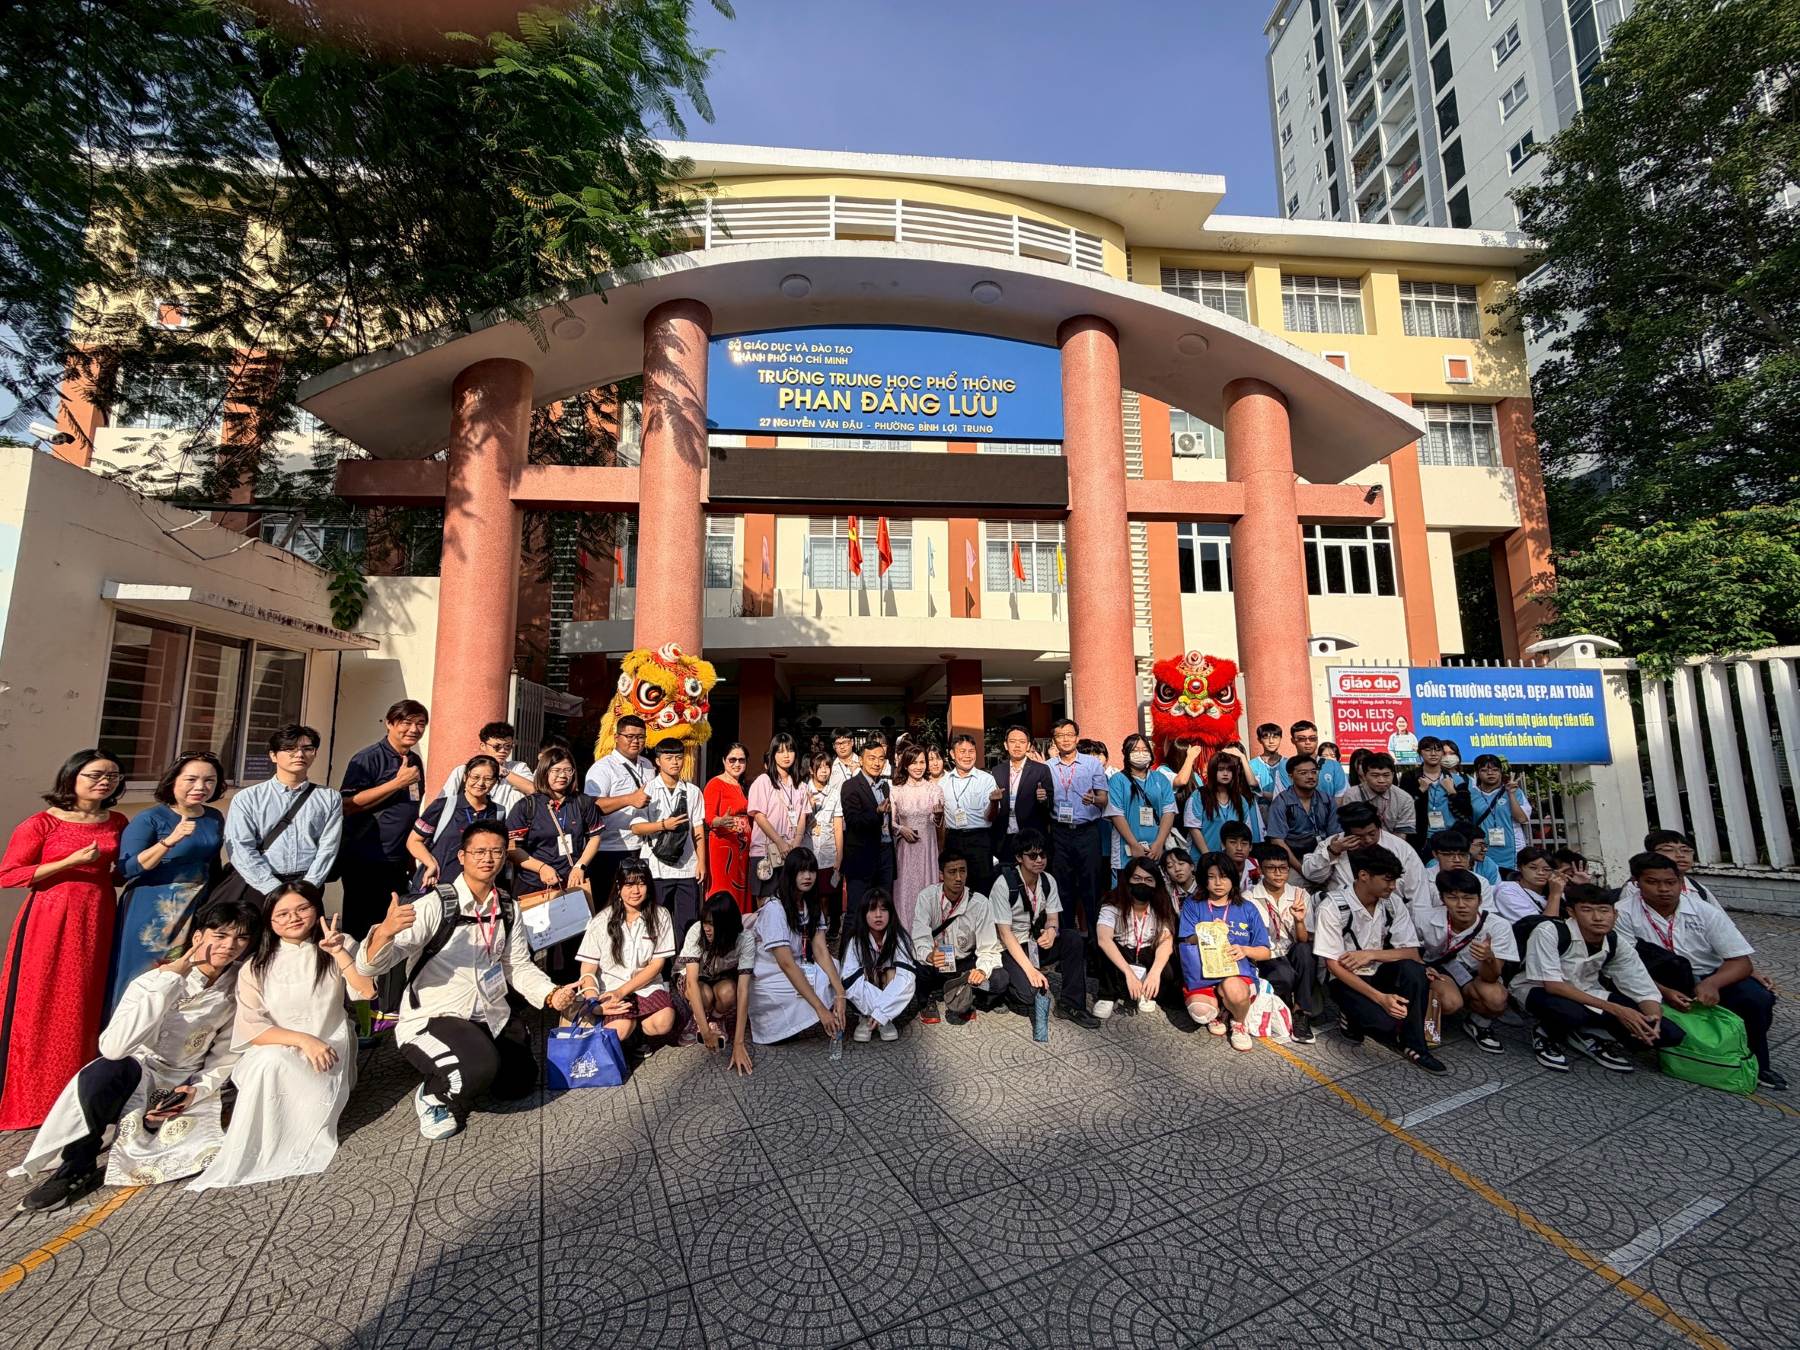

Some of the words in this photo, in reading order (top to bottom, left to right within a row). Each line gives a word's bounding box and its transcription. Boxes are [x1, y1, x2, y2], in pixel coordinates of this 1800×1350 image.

[743, 340, 769, 351] GIÁO
[771, 342, 793, 353] DỤC
[794, 342, 808, 352] VÀ
[811, 343, 832, 353] ĐÀO
[834, 345, 853, 355] TẠO
[767, 351, 787, 363] PHỐ
[805, 354, 822, 364] CHÍ
[824, 356, 848, 365] MINH
[758, 367, 825, 385] TRƯỜNG
[829, 372, 883, 388] TRUNG
[887, 375, 922, 392] HỌC
[926, 370, 958, 391] PHỔ
[961, 375, 1017, 393] THÔNG
[779, 387, 851, 412] PHAN
[861, 387, 941, 415] ĐĂNG
[949, 391, 998, 417] LƯU
[759, 418, 771, 428] 27
[819, 419, 839, 429] VĂN
[842, 419, 863, 431] ĐẬU
[874, 420, 915, 432] PHƯỜNG
[918, 421, 939, 432] BÌNH
[942, 423, 958, 434] LỢI
[962, 424, 993, 433] TRUNG
[1341, 675, 1372, 690] giáo
[1373, 676, 1399, 691] dục
[1415, 680, 1447, 698] CỔNG
[1448, 682, 1492, 699] TRƯỜNG
[1494, 684, 1526, 701] SẠCH,
[1550, 685, 1564, 699] AN
[1565, 682, 1594, 699] TOÀN
[1338, 708, 1363, 719] DOL
[1365, 708, 1395, 719] IELTS
[1339, 719, 1368, 732] ĐÌNH
[1371, 721, 1394, 734] LỰC
